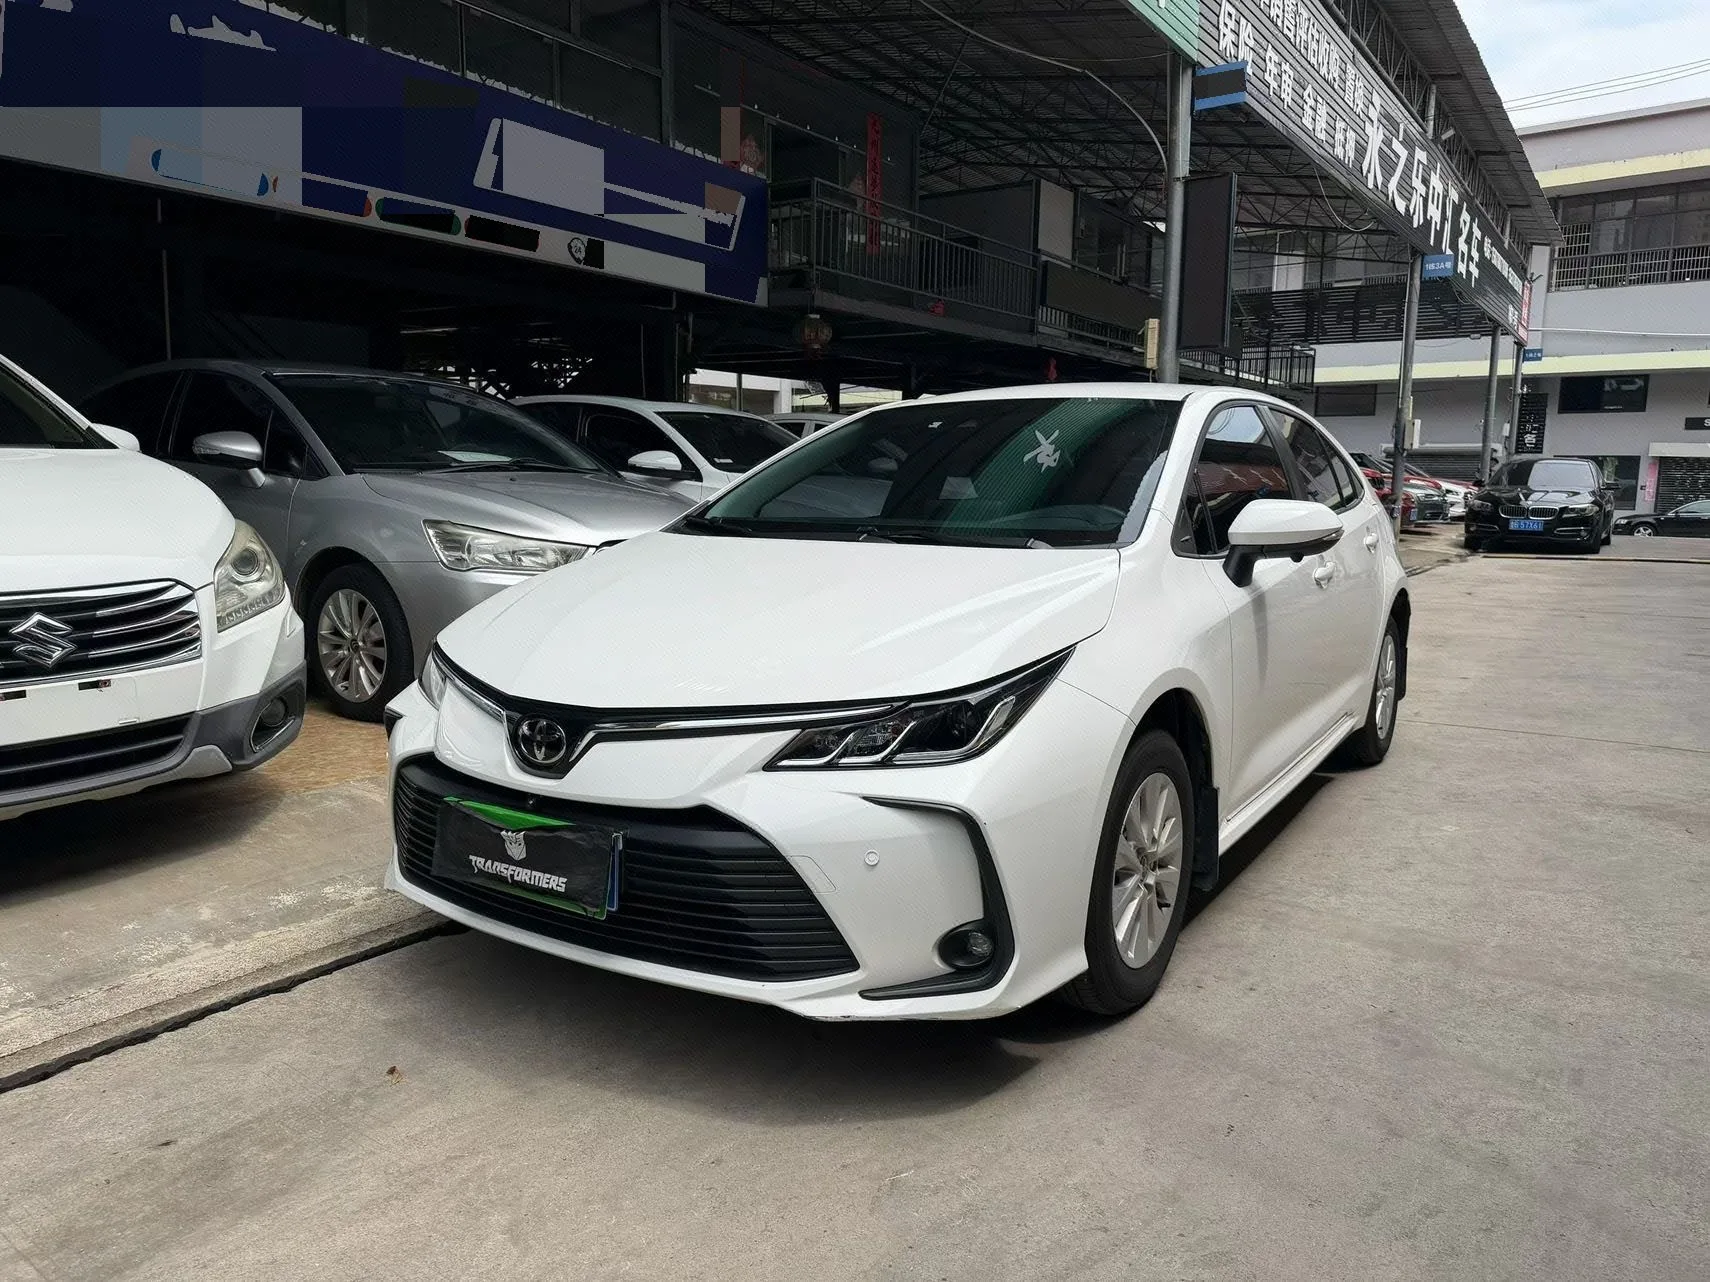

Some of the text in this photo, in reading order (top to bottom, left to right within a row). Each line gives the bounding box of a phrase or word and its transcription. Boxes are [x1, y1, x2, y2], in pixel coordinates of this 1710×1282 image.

[1219, 0, 1356, 168] 保险 年审 金融 抵押
[1344, 63, 1365, 119] 置换
[1361, 88, 1482, 288] 永之乐中汇名车
[469, 854, 568, 892] TRANSFORMERS
